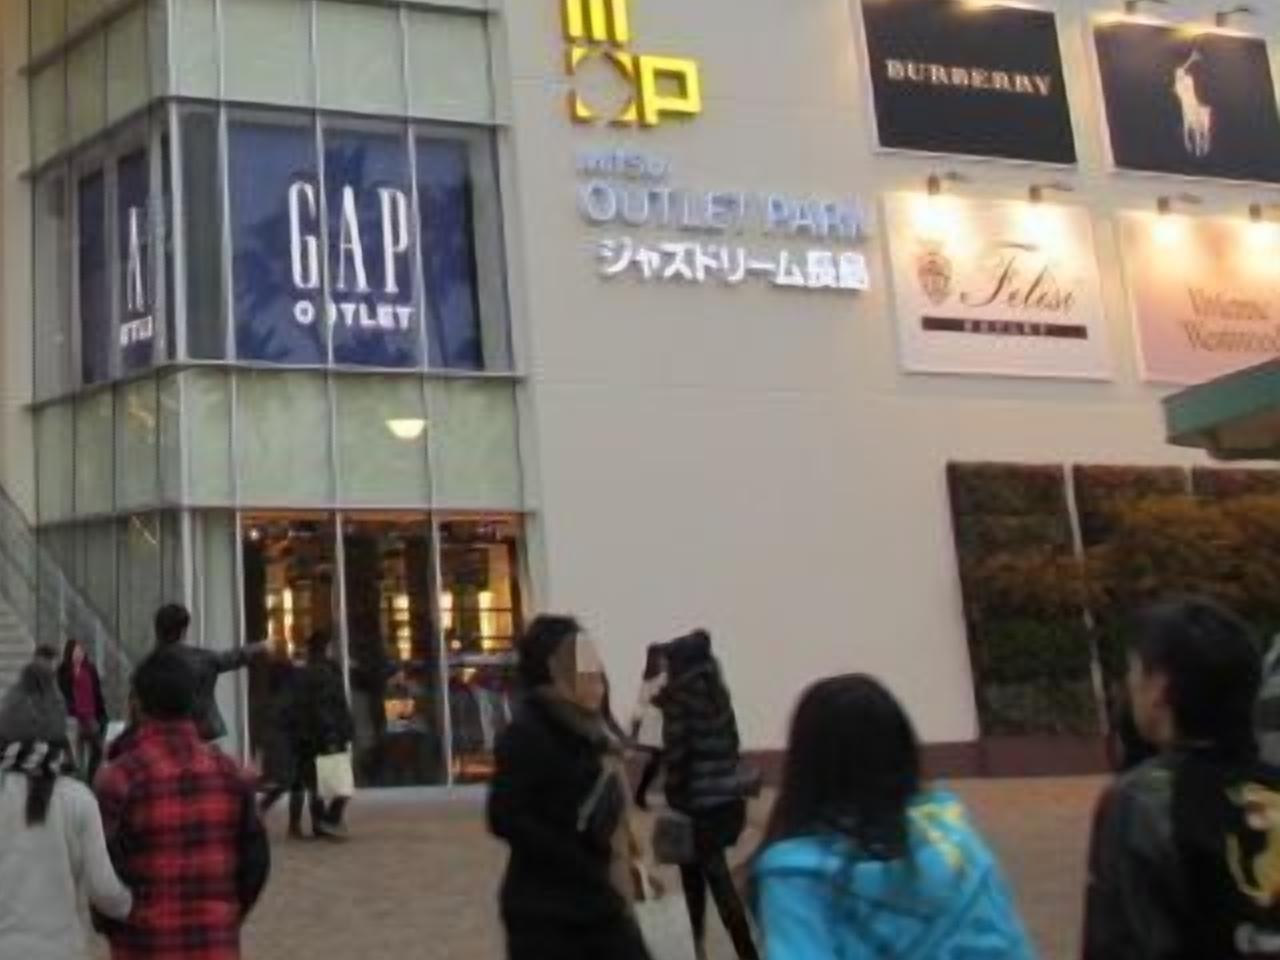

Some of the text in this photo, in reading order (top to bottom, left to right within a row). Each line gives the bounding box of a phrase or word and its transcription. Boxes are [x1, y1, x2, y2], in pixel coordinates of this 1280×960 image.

[886, 59, 1051, 95] BURBERRY
[586, 183, 745, 230] OUTLET
[288, 181, 409, 294] GAP
